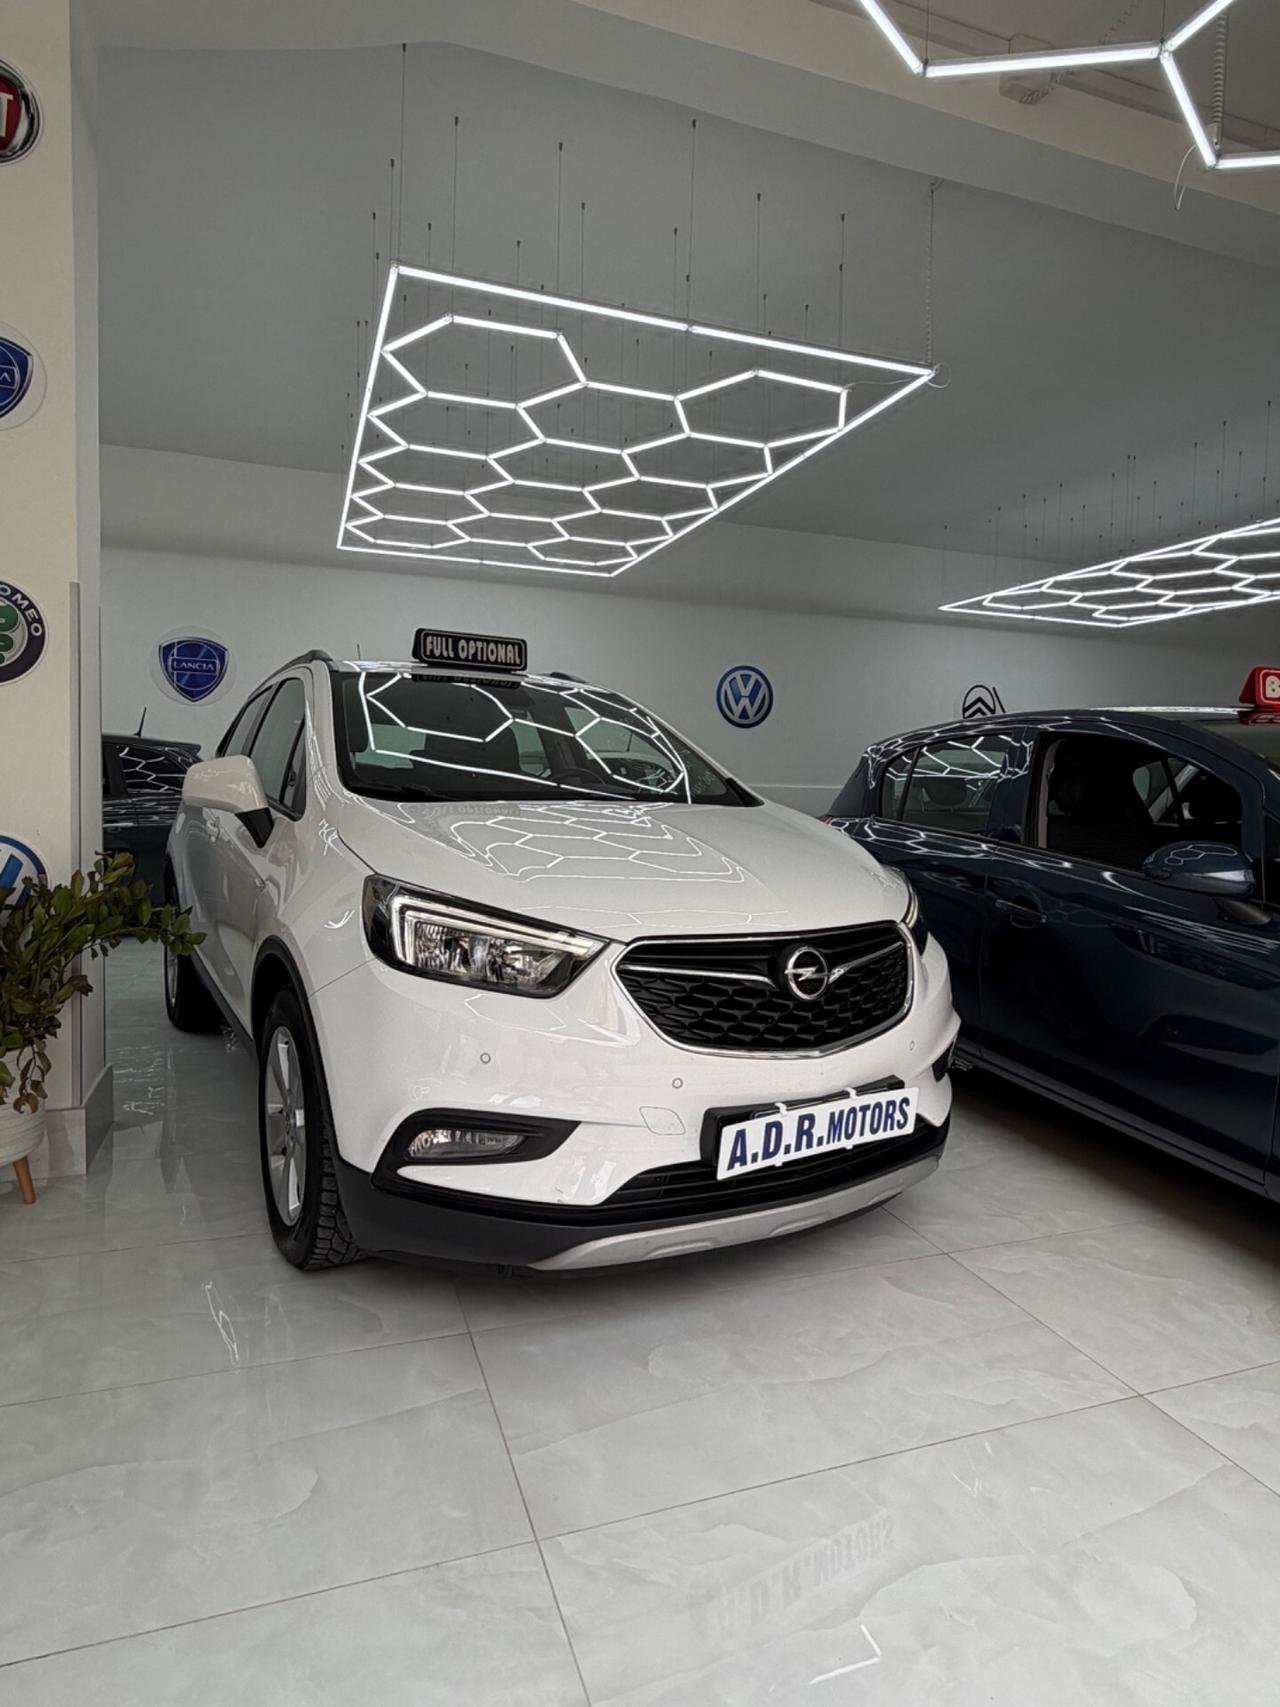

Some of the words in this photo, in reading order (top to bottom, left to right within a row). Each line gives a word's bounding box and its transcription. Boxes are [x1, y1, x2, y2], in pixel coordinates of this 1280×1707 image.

[0, 584, 42, 637] OMEO
[426, 636, 454, 658] FULL
[458, 639, 521, 665] OPTIONAL
[173, 660, 215, 671] LANCIA
